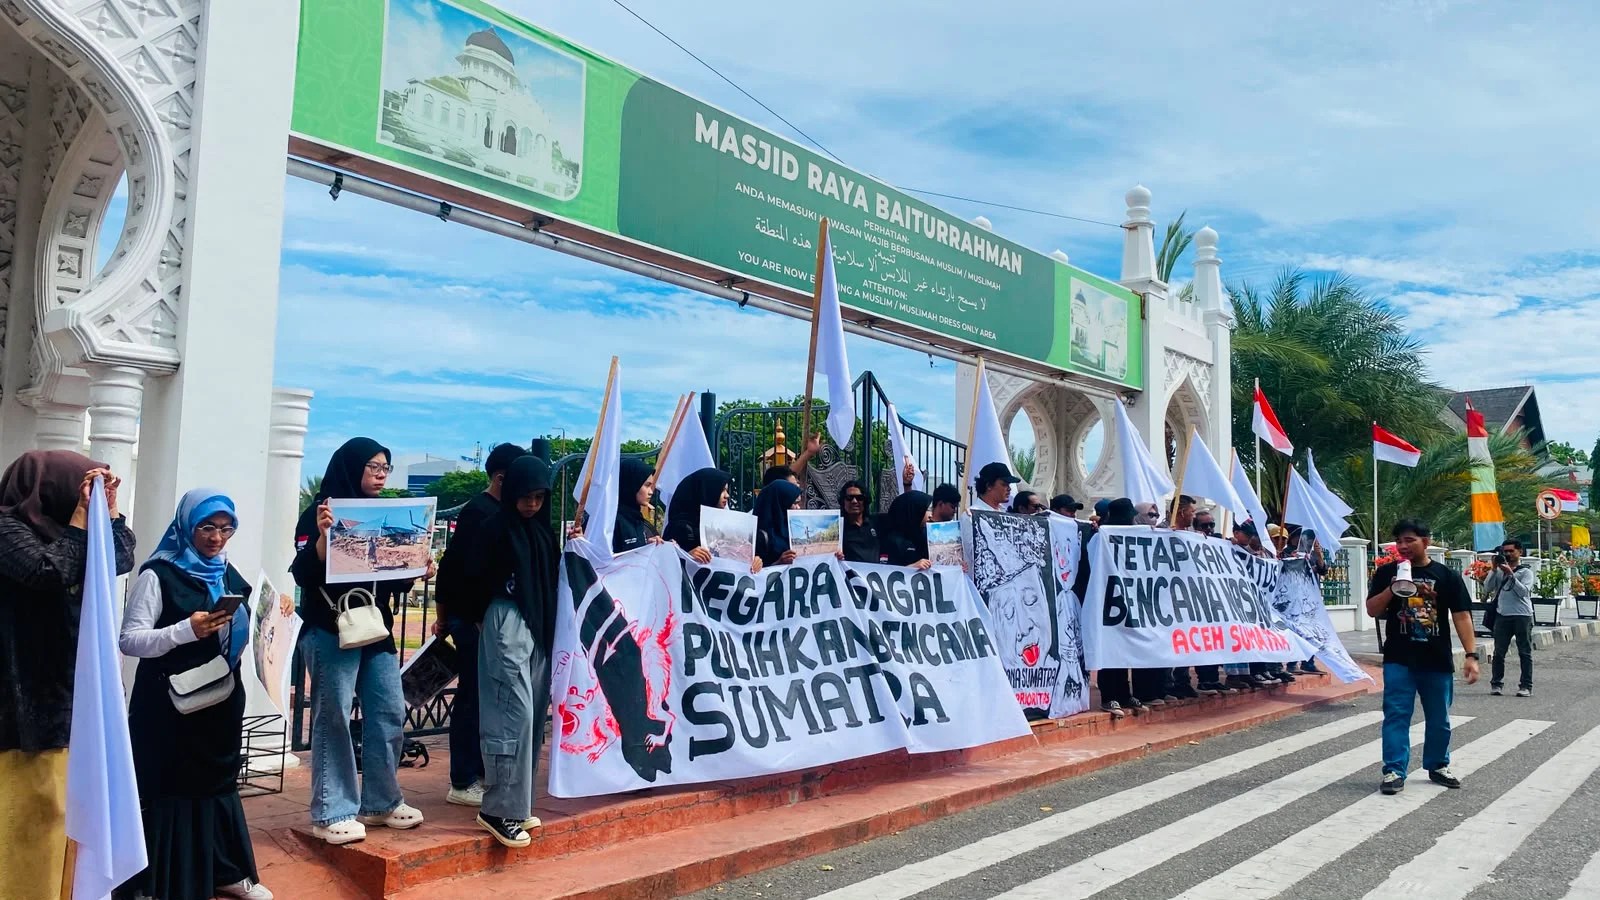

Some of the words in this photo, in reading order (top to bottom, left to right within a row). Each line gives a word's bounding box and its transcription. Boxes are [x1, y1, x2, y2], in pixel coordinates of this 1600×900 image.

[694, 112, 800, 182] MASJID
[808, 162, 869, 213] RAYA
[875, 192, 1023, 276] BAITURRAHMAN
[735, 182, 765, 201] ANDA
[767, 194, 817, 221] MEMASUKI
[863, 231, 889, 248] WAJIB
[890, 242, 936, 266] BERBUSANA
[936, 259, 963, 278] MUSLIM
[967, 273, 1001, 291] MUSLIMAH
[755, 216, 789, 242] المنطقة
[793, 233, 812, 249] هذه
[864, 219, 909, 244] PERHATIAN:
[738, 250, 759, 266] YOU
[762, 259, 782, 273] ARE
[783, 266, 808, 281] NOW
[854, 289, 861, 298] A
[862, 291, 893, 309] MUSLIM
[899, 302, 938, 322] MUSLIMAH
[938, 315, 961, 329] DRESS
[961, 322, 979, 335] ONLY
[979, 328, 997, 341] AREA
[862, 279, 908, 300] ATTENTION:
[1109, 534, 1233, 575] TETAPKAN
[679, 557, 843, 626] NEGARA
[844, 568, 957, 617] GAGAL
[1102, 575, 1230, 628] BENCANA
[682, 615, 874, 681] PULIHKAN
[868, 617, 998, 667] BENCANA
[1171, 625, 1225, 655] ACEH
